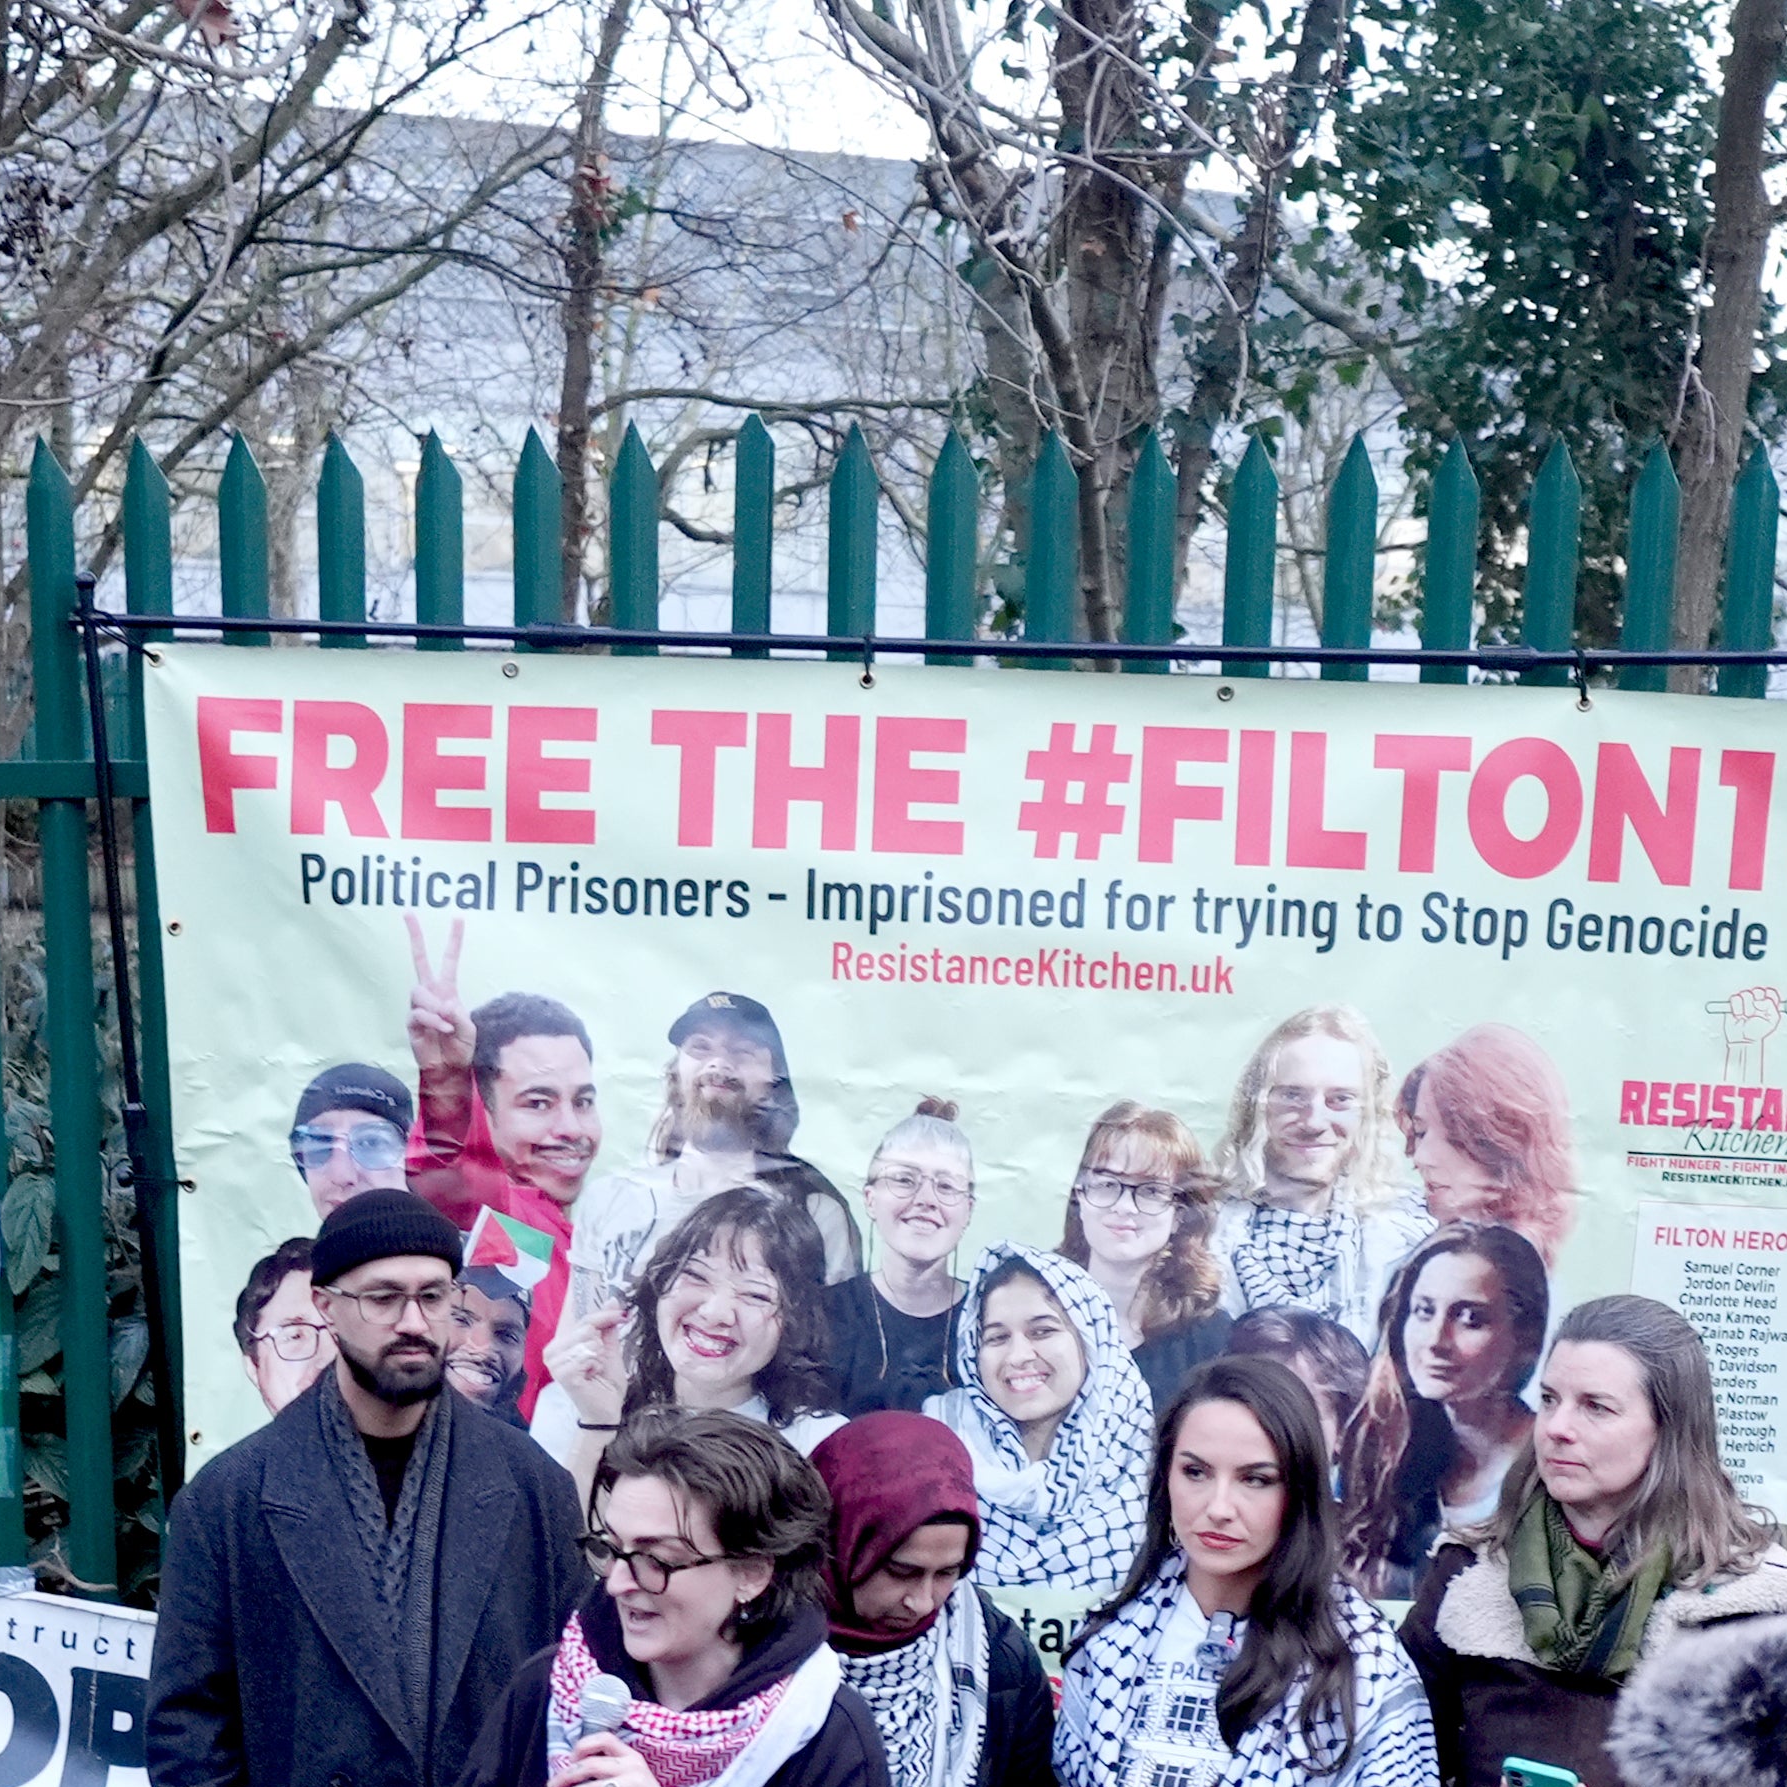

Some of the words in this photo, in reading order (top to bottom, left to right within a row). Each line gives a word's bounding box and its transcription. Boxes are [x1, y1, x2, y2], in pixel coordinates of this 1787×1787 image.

[196, 696, 599, 847] FREE
[651, 709, 968, 856] THE
[300, 853, 497, 913] Political
[515, 860, 751, 919] Prisoners
[806, 867, 1085, 934] Imprisoned
[1106, 878, 1176, 933] for
[1194, 883, 1336, 953] trying
[1358, 892, 1403, 944] to
[1422, 891, 1529, 961] Stop
[1546, 899, 1769, 962] Genocide
[831, 941, 1234, 996] ResistanceKitchen.uk
[1626, 1156, 1666, 1169] FIGHT
[1669, 1159, 1721, 1172] HUNGER
[1732, 1162, 1771, 1175] FIGHT
[1654, 1226, 1726, 1249] FILTON
[1684, 1260, 1733, 1275] Samuel
[1736, 1263, 1781, 1277] Corner
[1684, 1277, 1731, 1292] Jordon
[1734, 1279, 1775, 1293] Devlin
[1679, 1293, 1739, 1308] Charlotte
[1743, 1296, 1778, 1309] Head
[1683, 1309, 1721, 1324] Leona
[1726, 1311, 1771, 1325] Kameo
[1701, 1326, 1745, 1340] Zainab
[1715, 1343, 1759, 1360] Rogers
[1719, 1359, 1778, 1374] Davidson
[1726, 1392, 1779, 1406] Norman
[1717, 1407, 1769, 1421] Plastow
[1718, 1425, 1777, 1440] lebrough
[1724, 1440, 1775, 1453] Herbich
